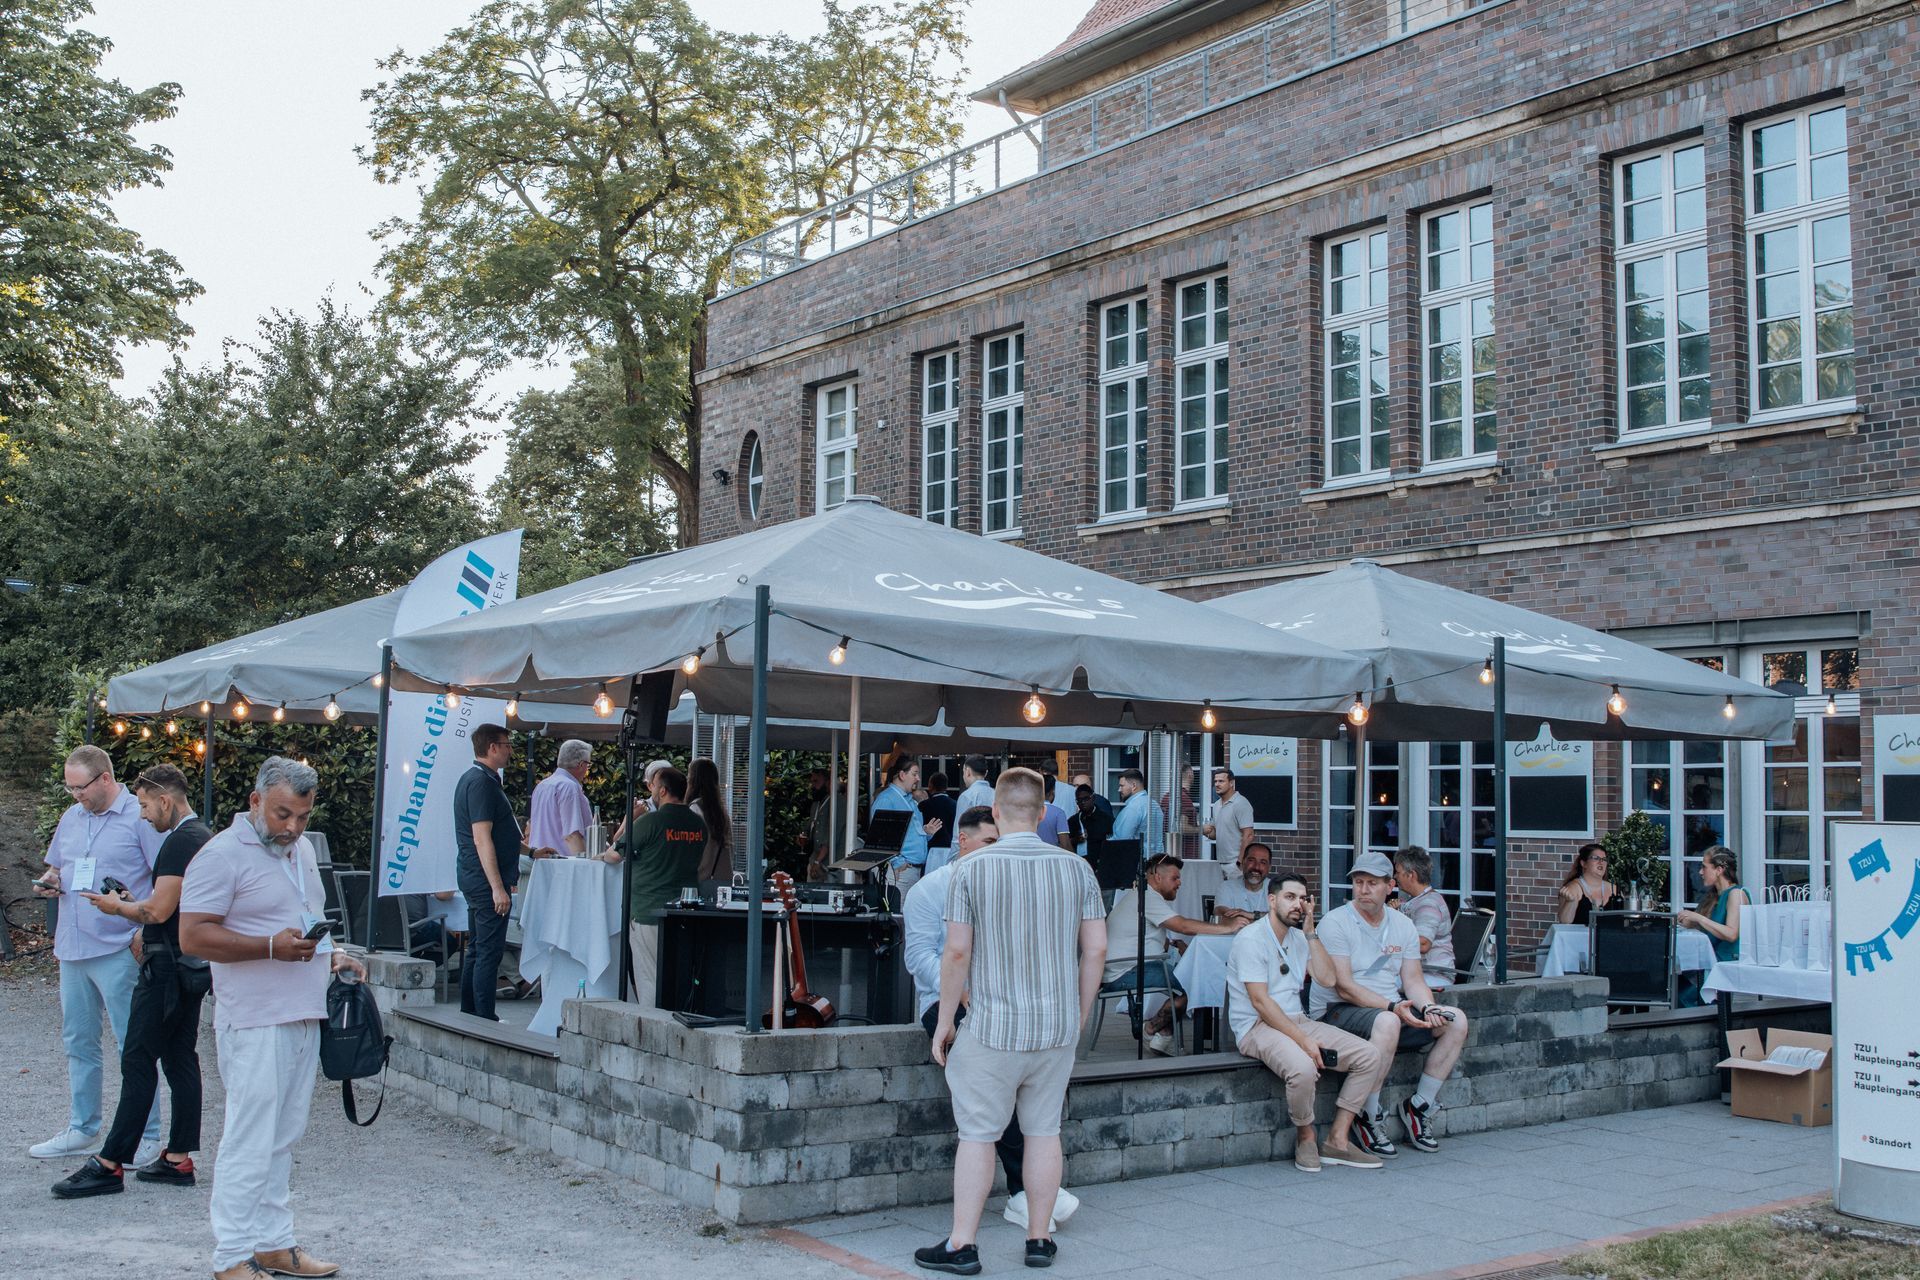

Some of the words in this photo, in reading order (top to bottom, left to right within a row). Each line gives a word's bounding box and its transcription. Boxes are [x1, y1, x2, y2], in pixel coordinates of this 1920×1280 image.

[874, 572, 1125, 610] Charlie's
[1237, 741, 1290, 759] Charlie's
[386, 742, 438, 889] elephants
[665, 828, 703, 844] Kumpel
[1857, 856, 1872, 869] TZU
[1905, 899, 1919, 916] TZU
[1856, 945, 1868, 953] TZU
[1854, 1043, 1872, 1053] TZU
[1854, 1053, 1920, 1070] Haupteingang
[1854, 1071, 1872, 1081] TZU
[1874, 1074, 1881, 1082] II
[1854, 1081, 1920, 1098] Haupteingang
[1868, 1135, 1912, 1149] Standort
